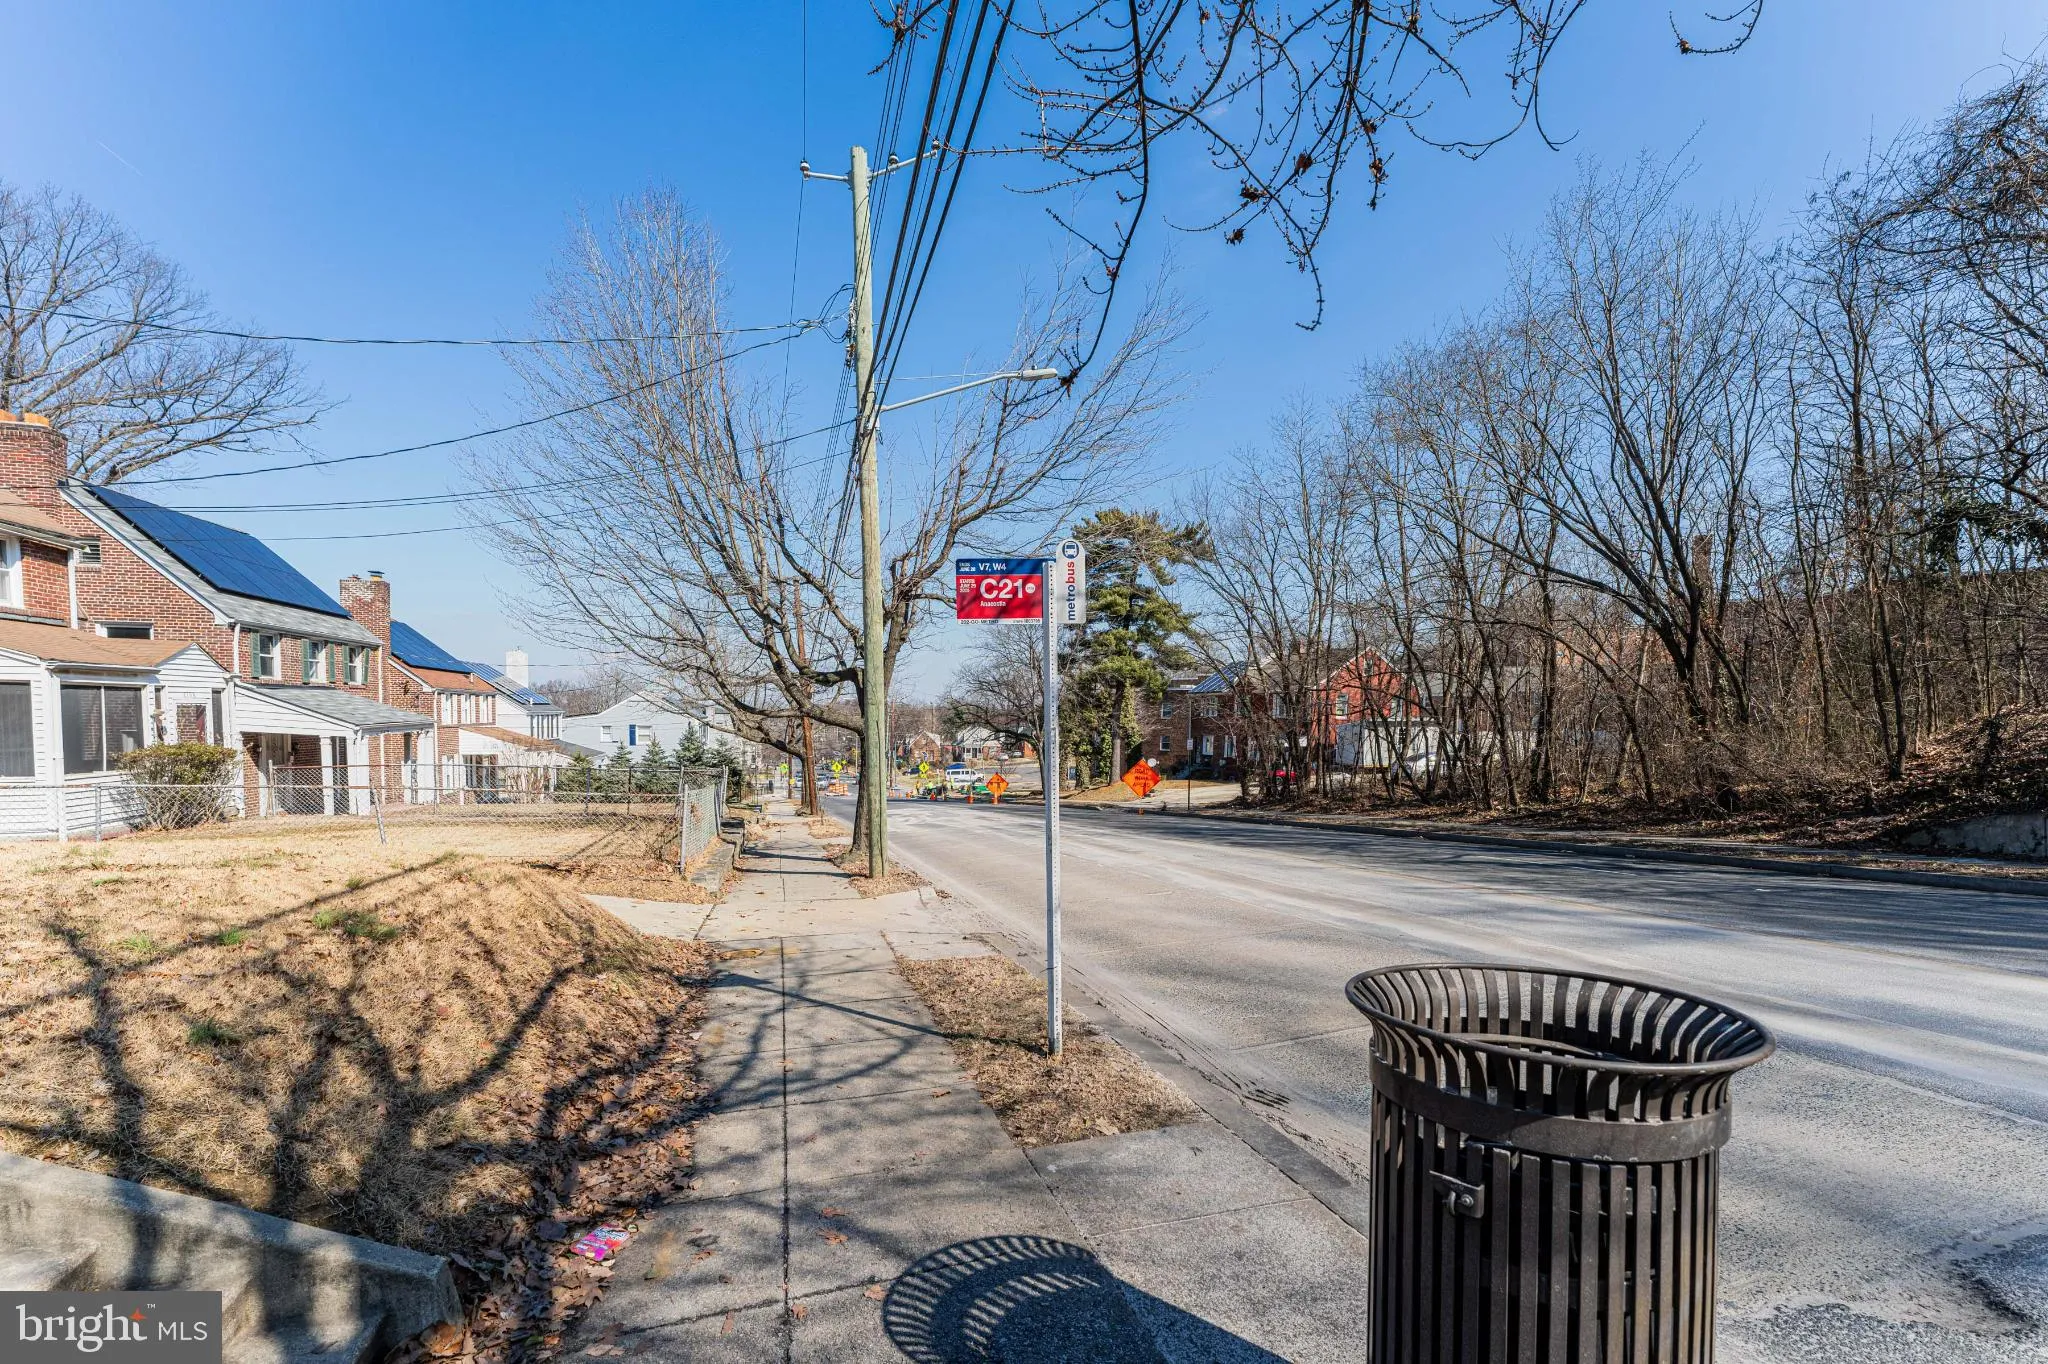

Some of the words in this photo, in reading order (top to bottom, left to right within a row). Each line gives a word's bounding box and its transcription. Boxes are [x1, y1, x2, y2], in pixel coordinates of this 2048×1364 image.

[979, 563, 991, 571] V7,
[992, 563, 1007, 571] W4
[980, 578, 1023, 599] C21
[1065, 561, 1076, 621] metrobus
